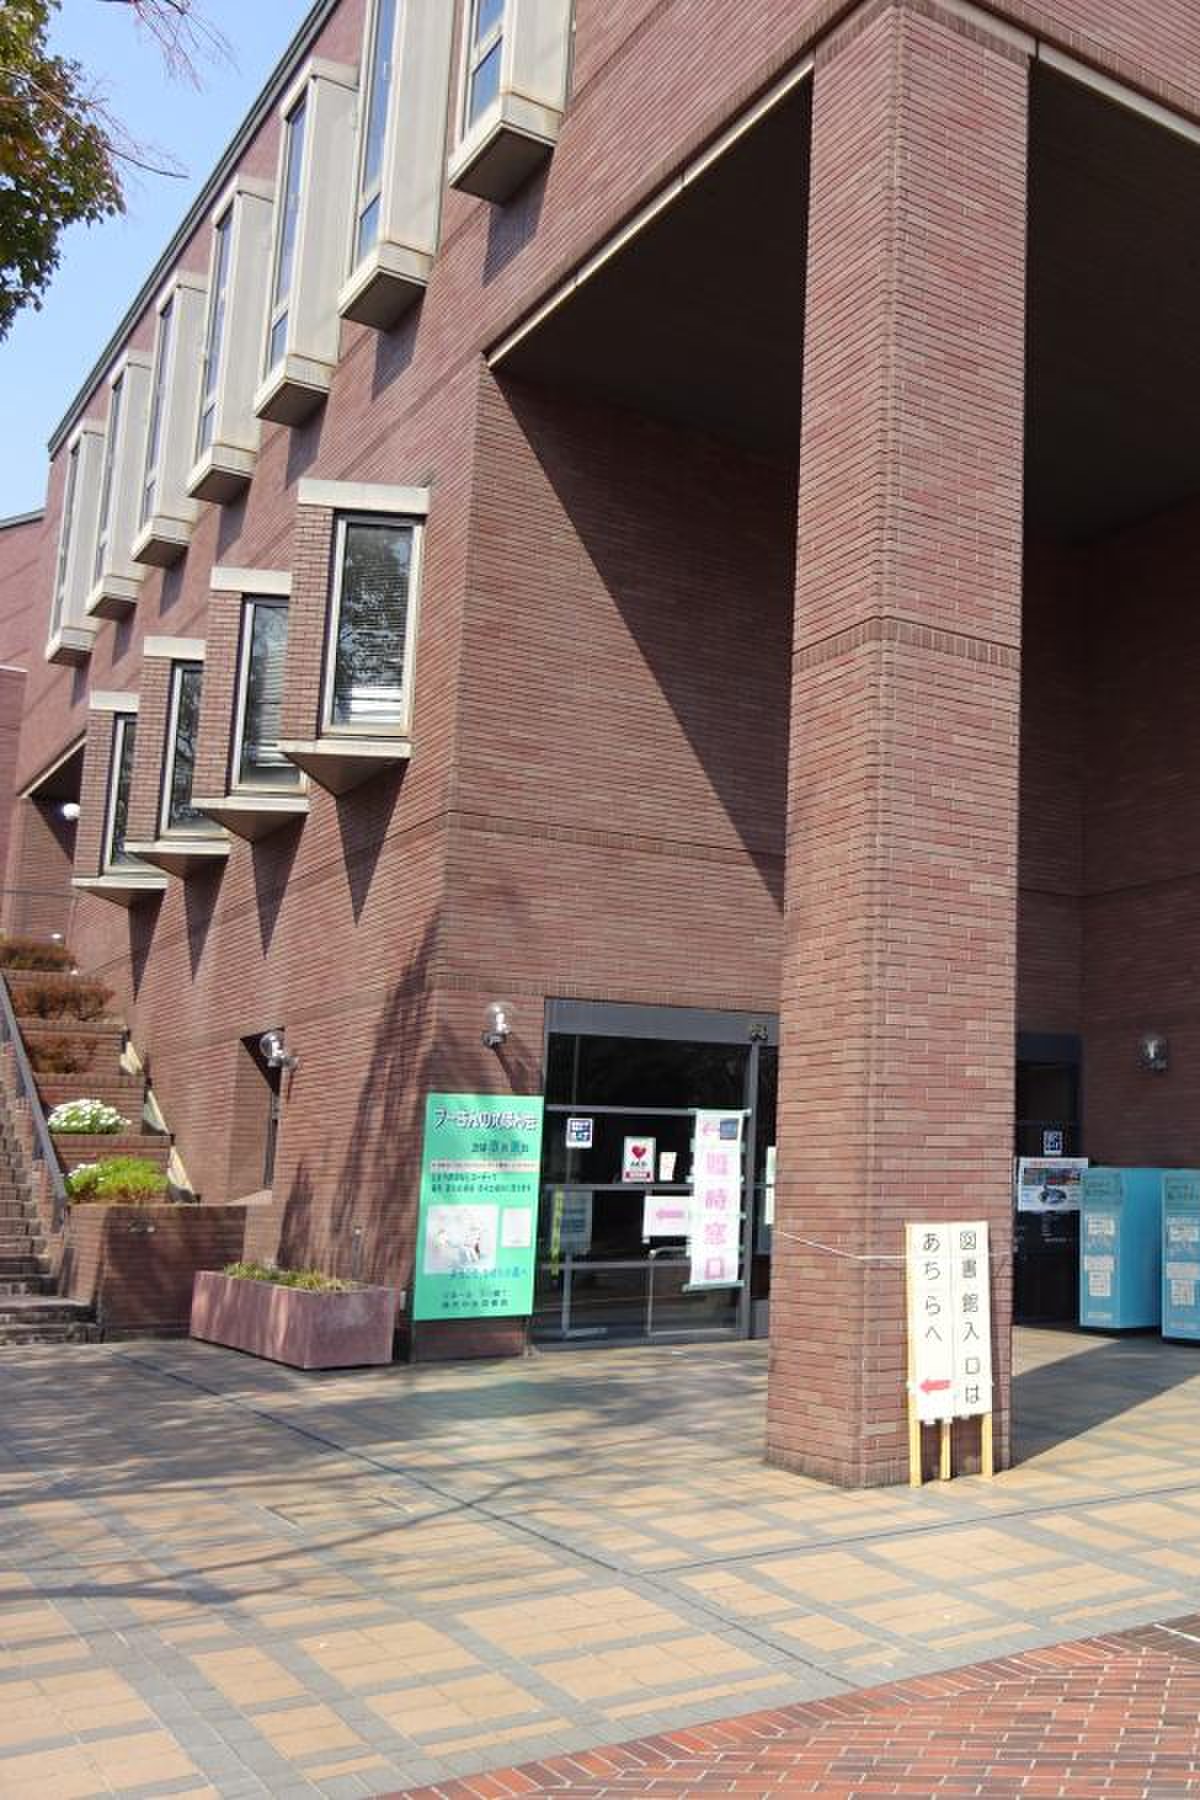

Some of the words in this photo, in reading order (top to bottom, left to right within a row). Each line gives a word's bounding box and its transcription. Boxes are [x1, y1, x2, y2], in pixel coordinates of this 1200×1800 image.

[922, 1232, 943, 1342] あちらへ
[960, 1231, 981, 1405] 図書館入口は
